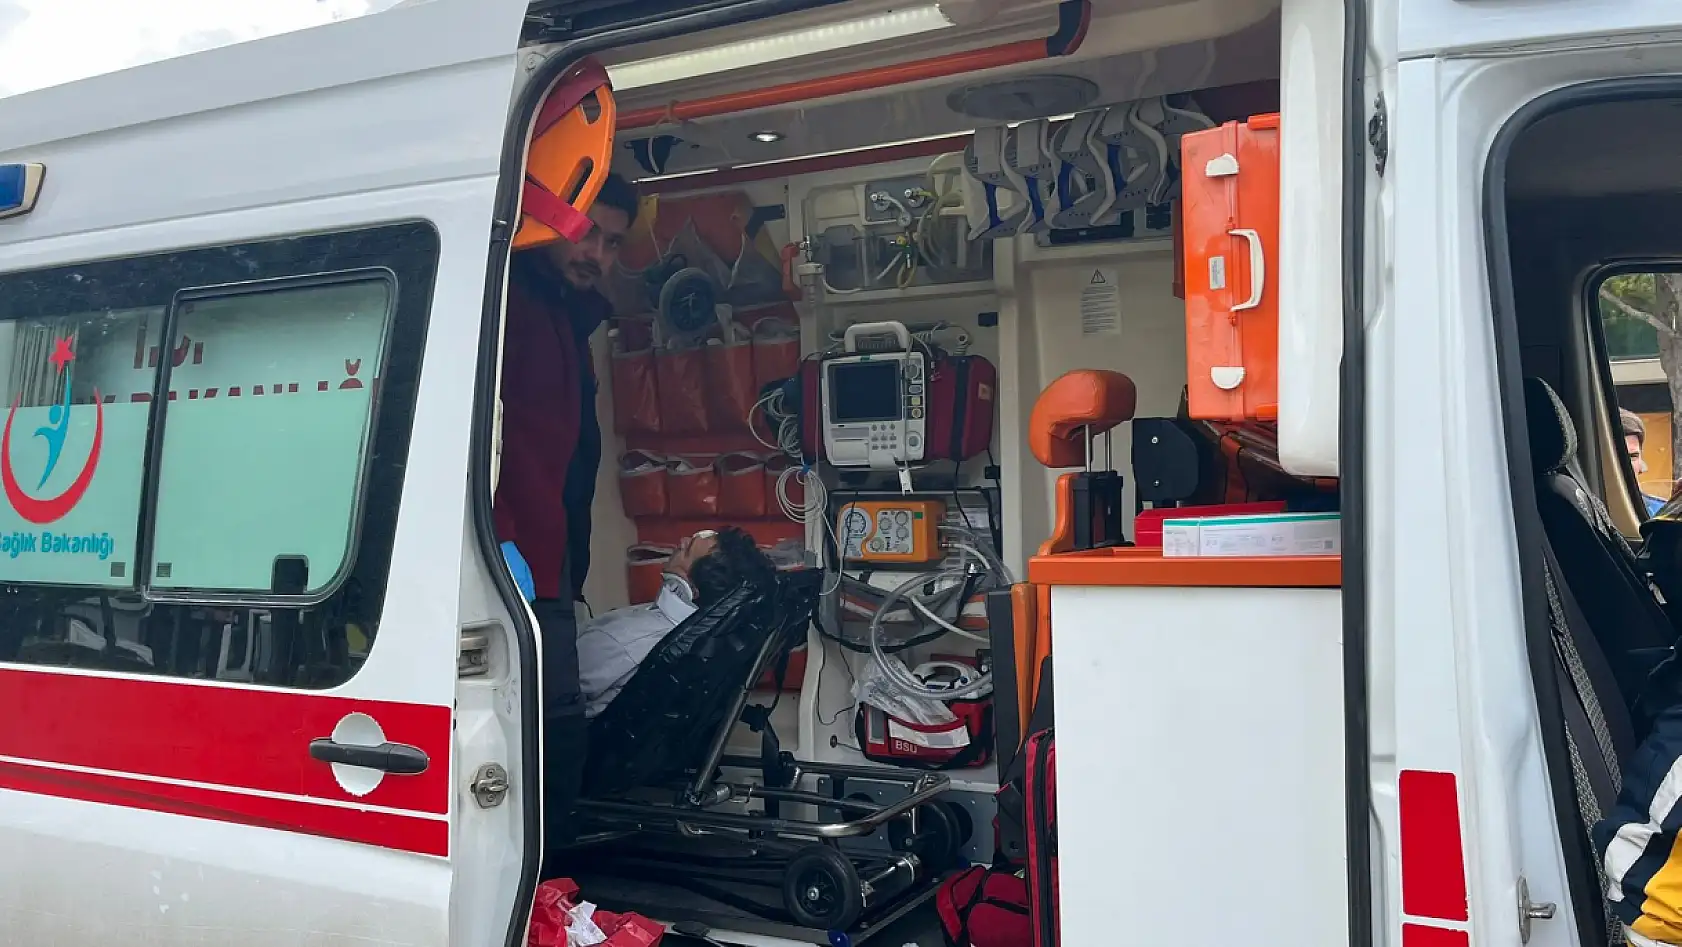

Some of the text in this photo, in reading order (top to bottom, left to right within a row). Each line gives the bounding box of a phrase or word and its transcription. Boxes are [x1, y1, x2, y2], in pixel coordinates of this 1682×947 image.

[0, 531, 114, 560] ağlık Bakanlığı
[896, 740, 917, 753] BSU
